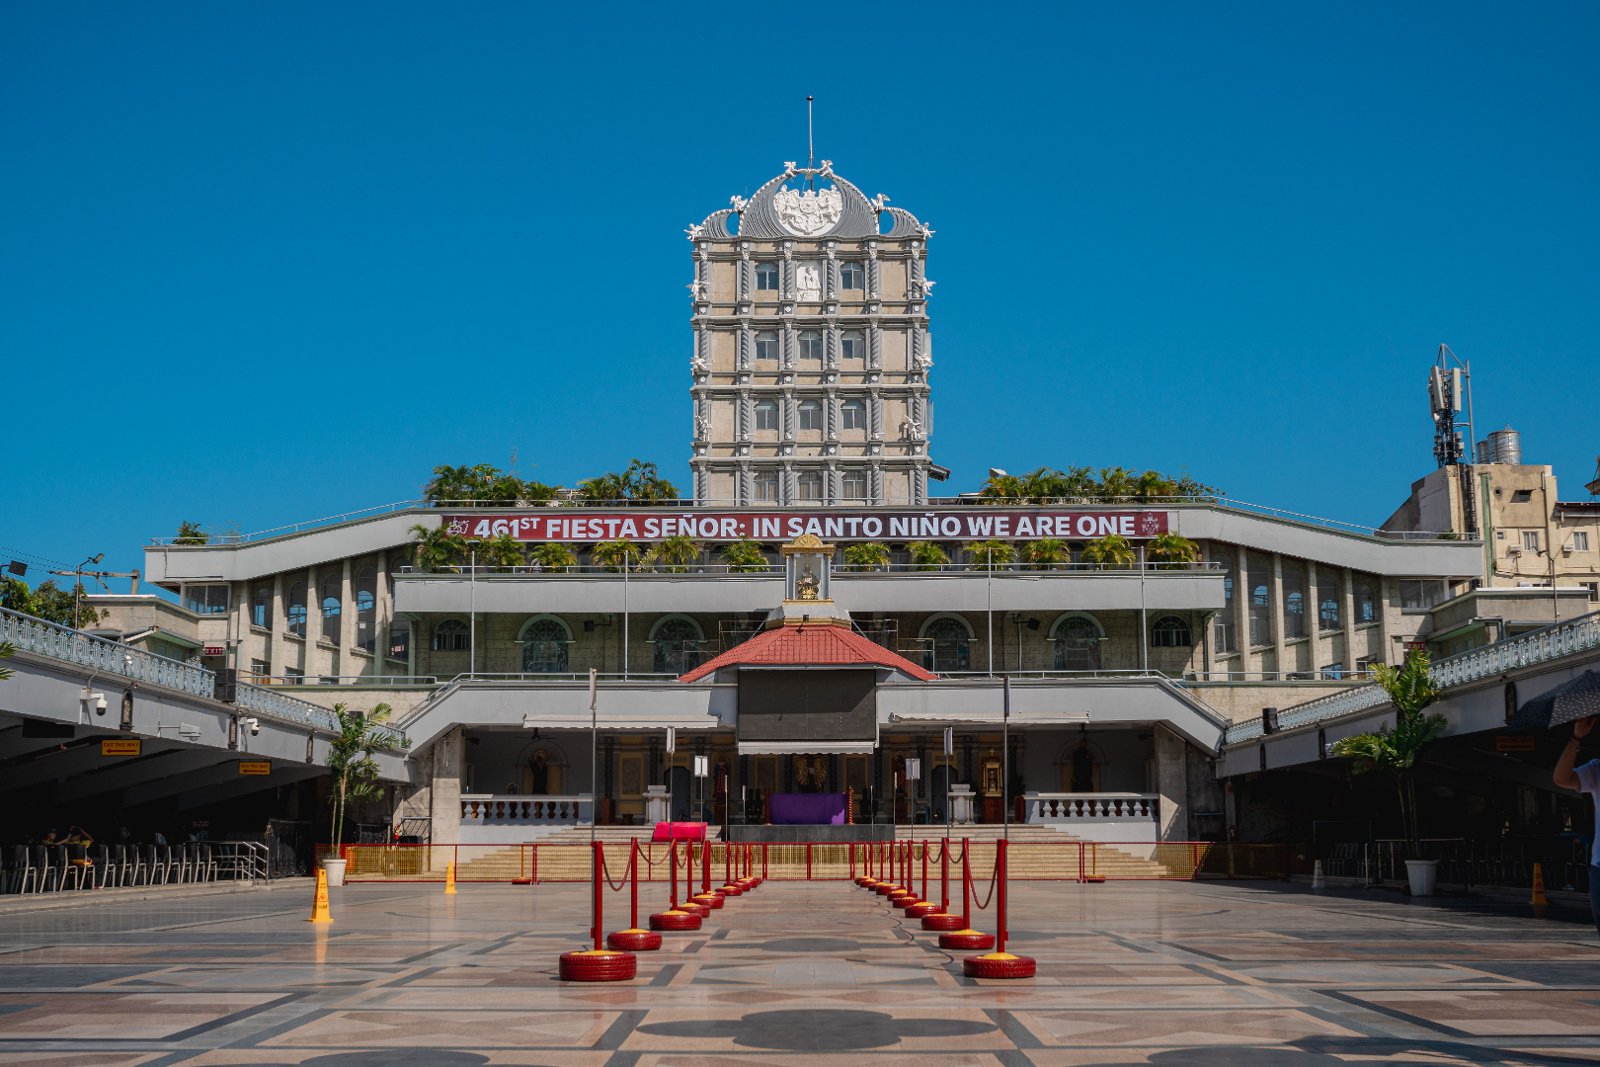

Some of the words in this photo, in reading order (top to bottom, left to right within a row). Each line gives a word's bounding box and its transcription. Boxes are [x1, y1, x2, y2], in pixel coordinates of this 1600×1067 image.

[546, 518, 639, 539] FIESTA
[643, 514, 746, 538] SEÑOR:
[753, 517, 780, 537] IN
[787, 517, 883, 537] SANTO
[889, 512, 962, 537] NIÑO
[966, 516, 1010, 536] WE
[1014, 516, 1071, 536] ARE
[1076, 515, 1136, 536] ONE
